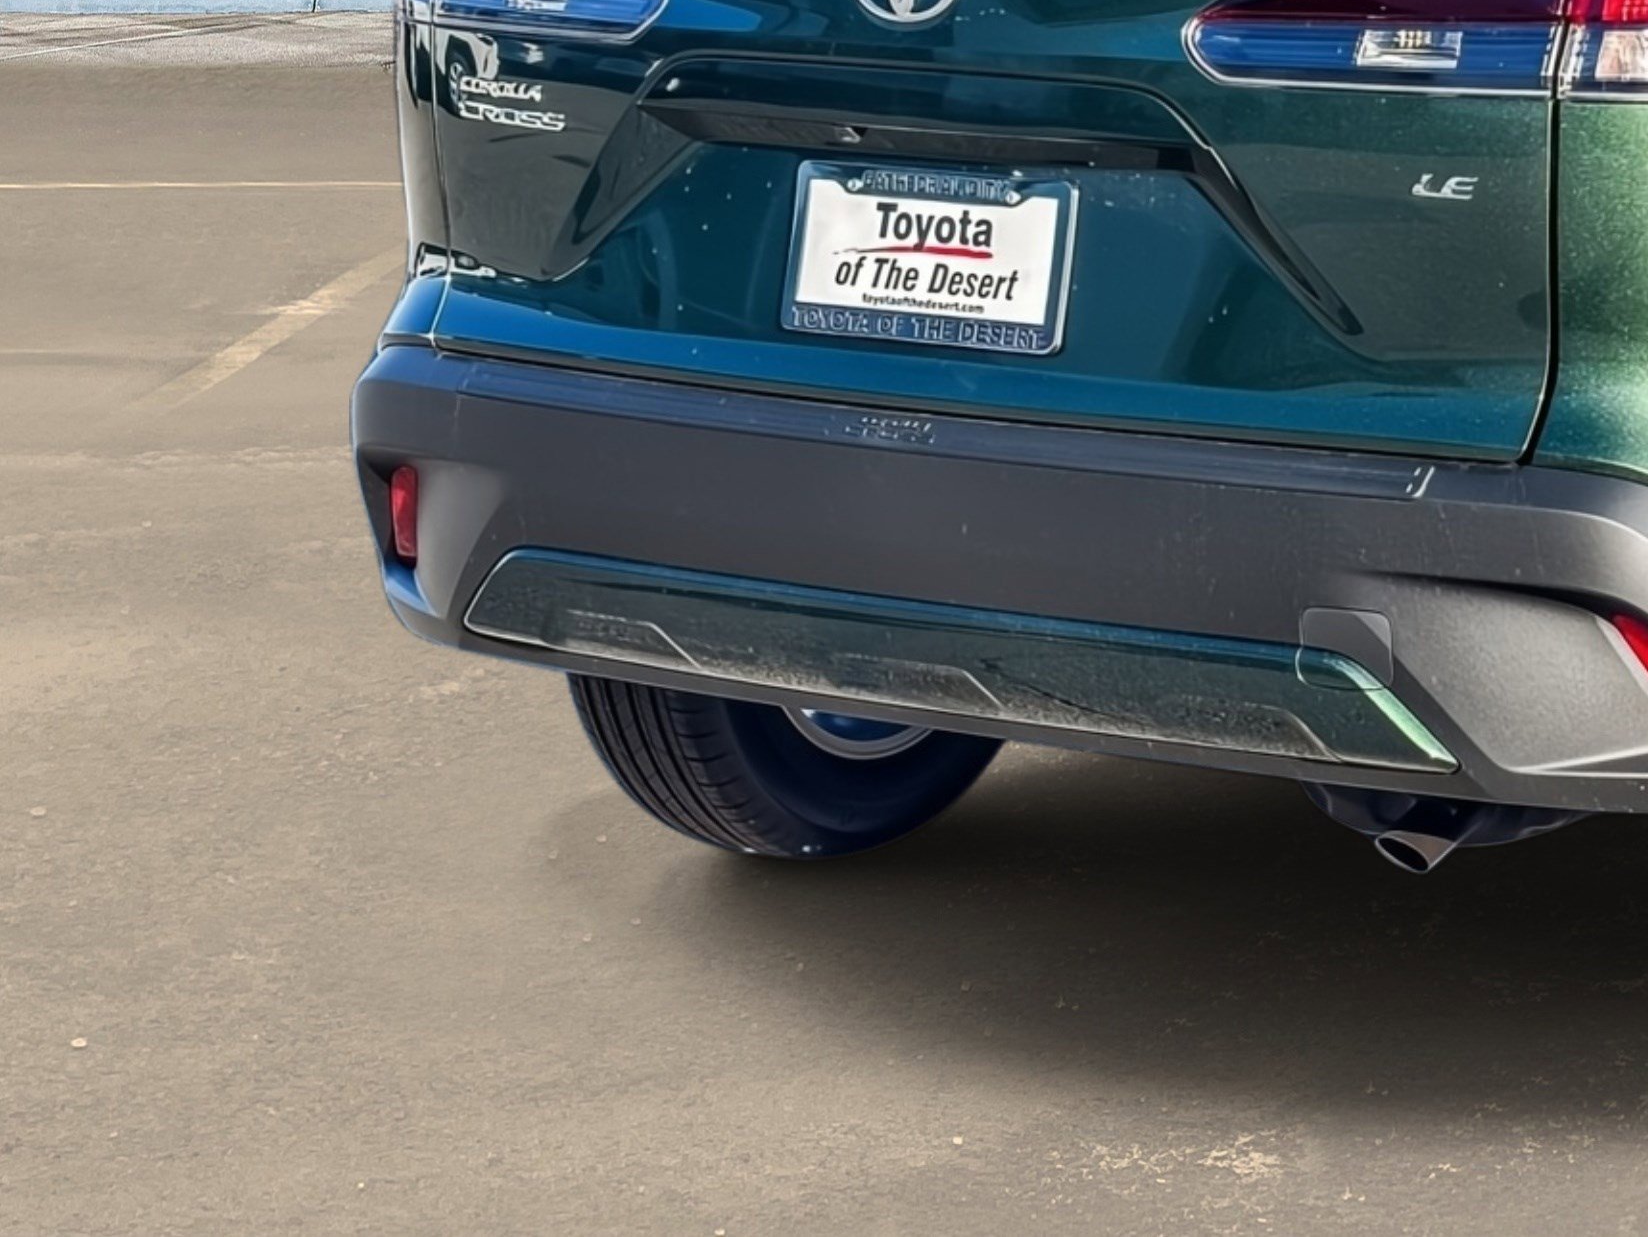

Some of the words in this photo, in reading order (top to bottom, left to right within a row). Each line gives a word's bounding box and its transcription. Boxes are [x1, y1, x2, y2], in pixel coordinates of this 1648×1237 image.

[458, 100, 567, 132] CROSS
[1411, 172, 1479, 200] LE
[876, 202, 993, 250] Toyota
[835, 256, 868, 287] of
[871, 258, 920, 292] The
[928, 263, 1019, 301] Desert
[861, 293, 985, 314] toyotaofthedesert.com
[792, 305, 868, 333] TOYOTA
[876, 314, 904, 337] OF
[911, 317, 951, 340] THE
[957, 320, 1046, 350] DESERT
